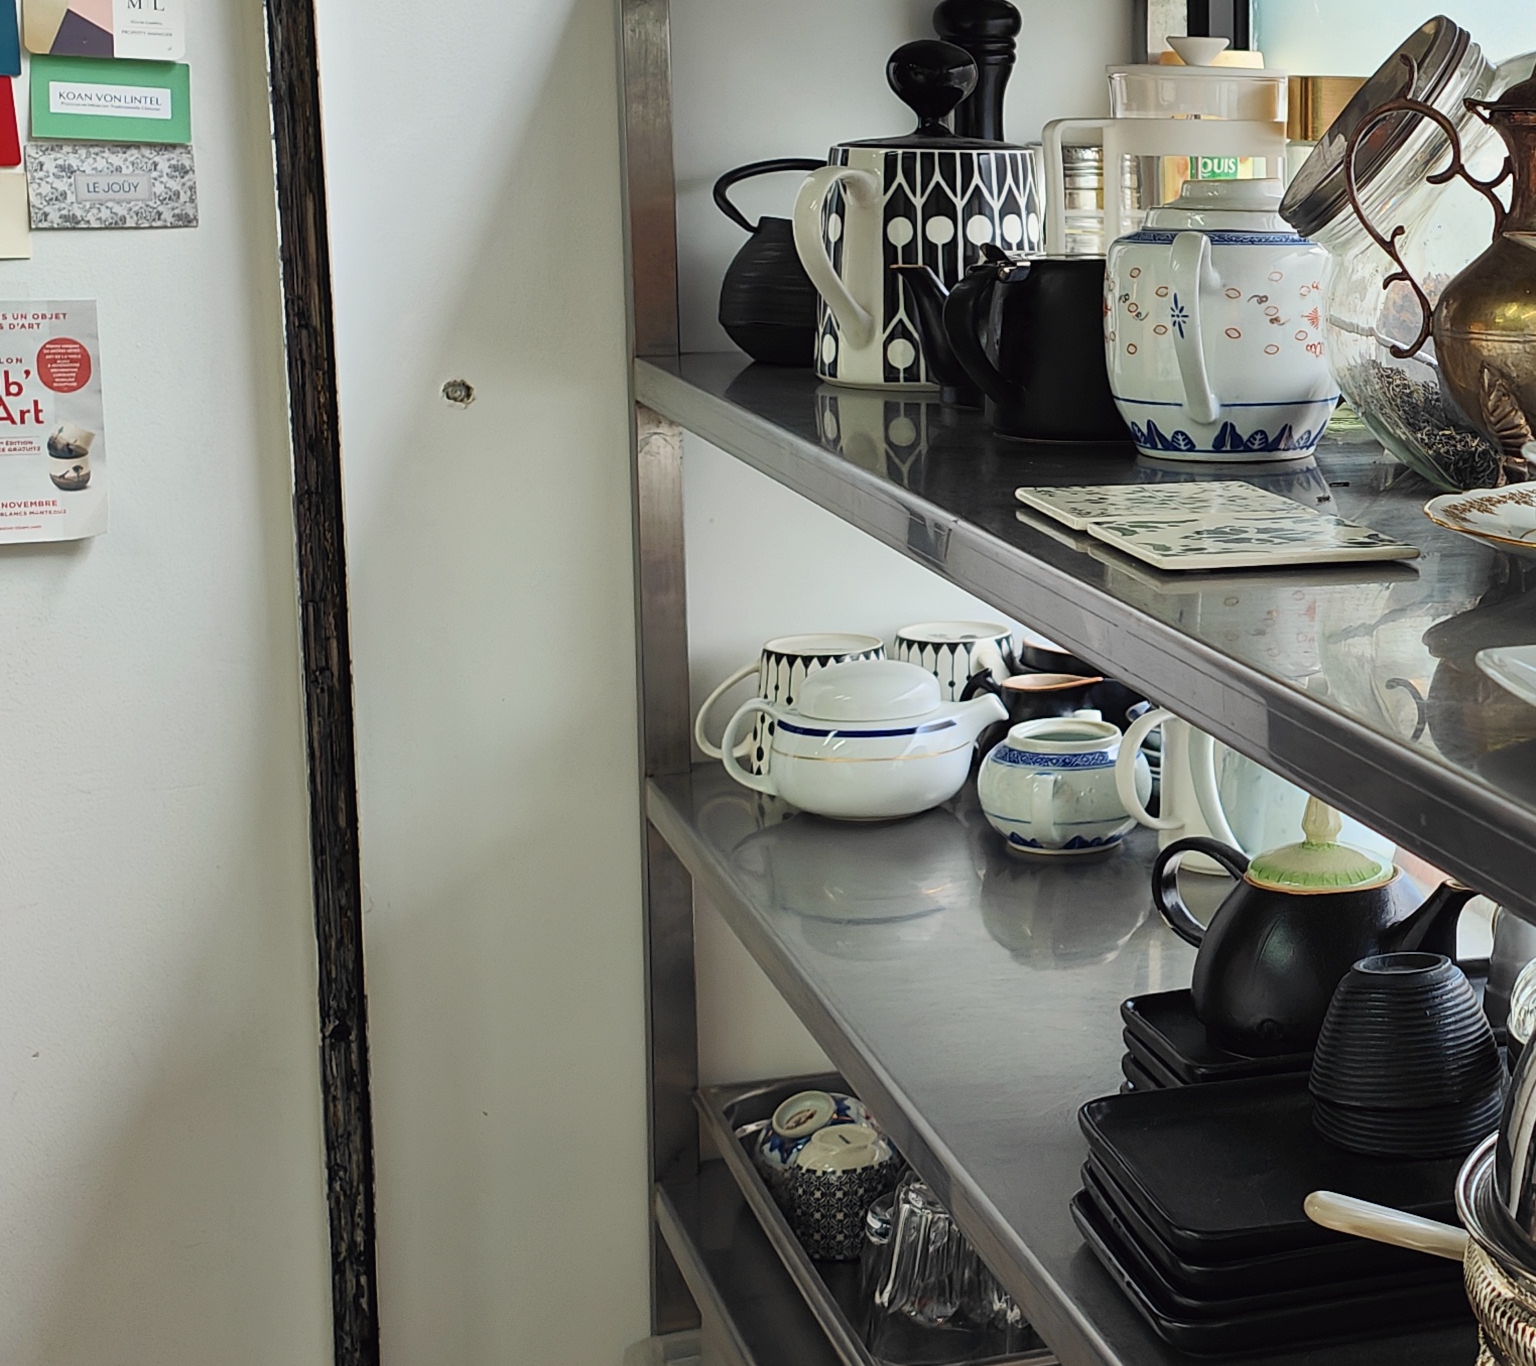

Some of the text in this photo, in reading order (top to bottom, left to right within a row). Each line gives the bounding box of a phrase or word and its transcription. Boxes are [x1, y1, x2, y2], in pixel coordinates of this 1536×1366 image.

[95, 93, 122, 103] VON
[124, 95, 162, 107] LINTEL
[86, 181, 100, 194] LE
[12, 312, 27, 321] UN
[32, 312, 67, 320] OBJET
[8, 322, 41, 330] D'ART
[1, 499, 57, 509] NOVEMBRE
